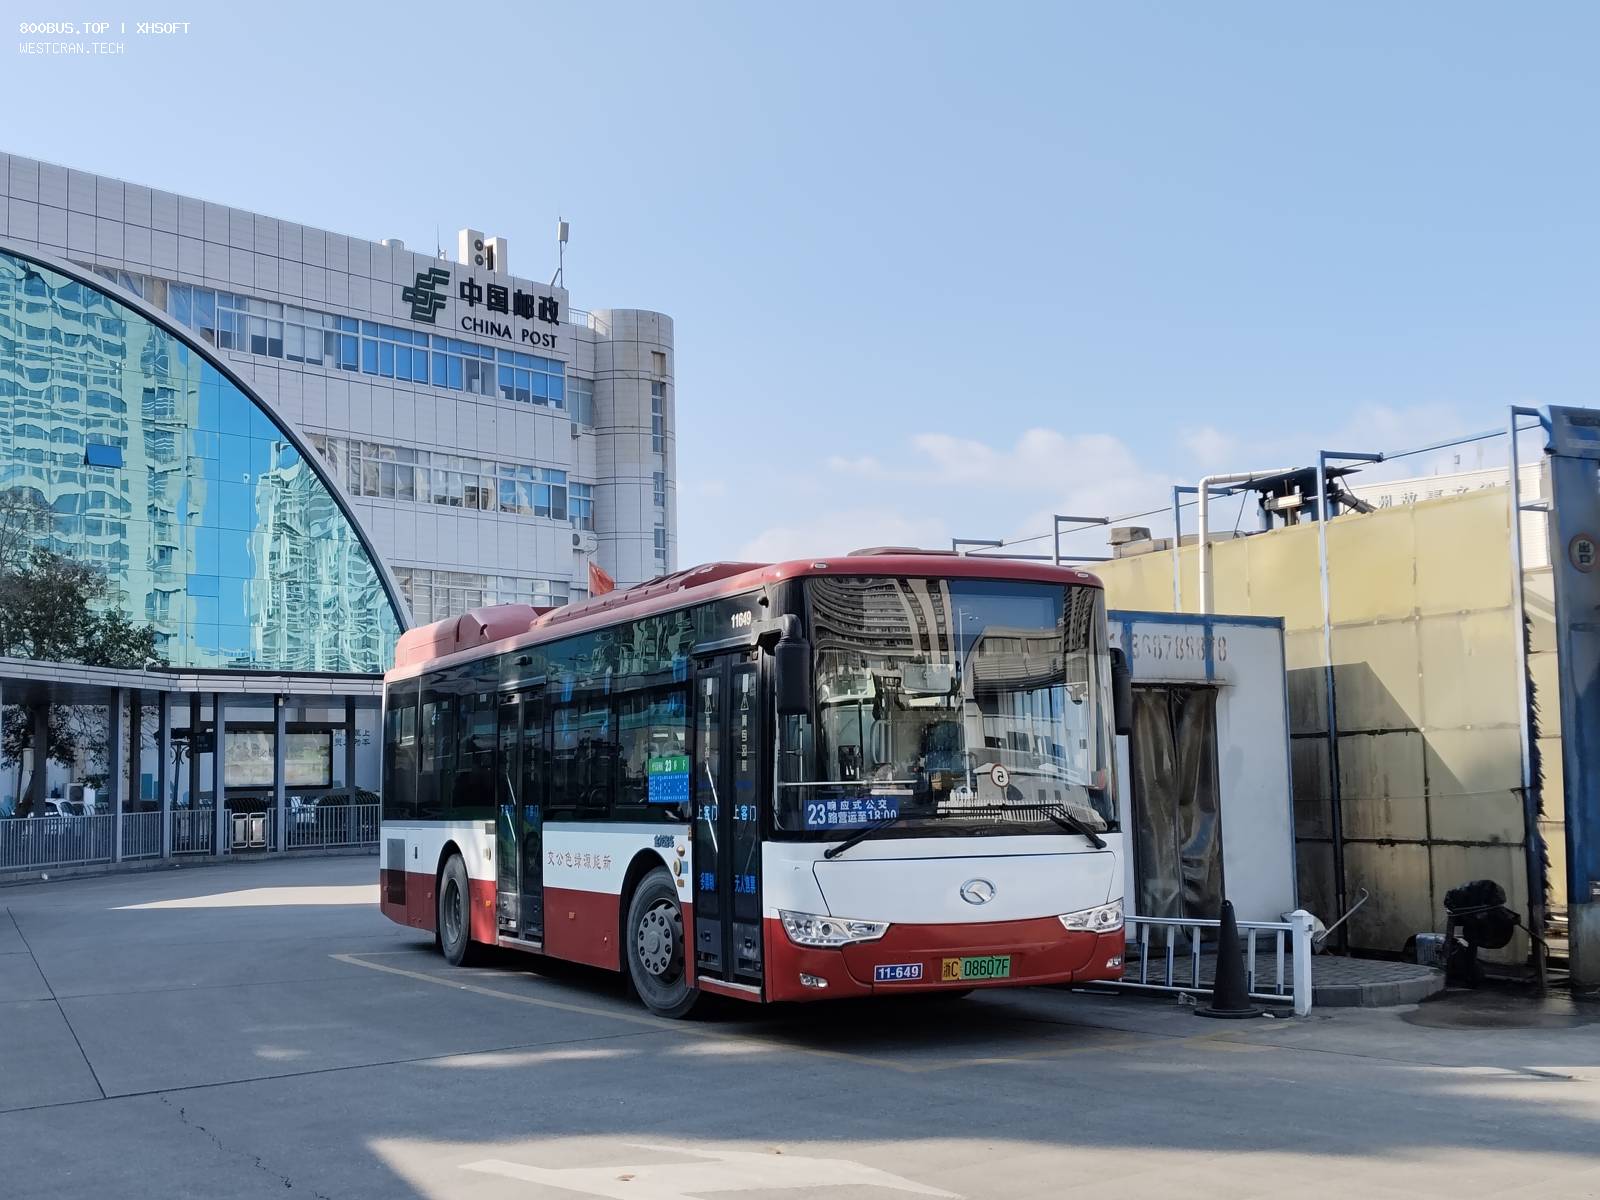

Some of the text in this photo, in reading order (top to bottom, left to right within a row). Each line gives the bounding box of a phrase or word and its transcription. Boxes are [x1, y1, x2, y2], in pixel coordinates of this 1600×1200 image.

[459, 277, 561, 326] 中国邮政
[461, 316, 558, 348] CHINA POST
[1579, 541, 1591, 563] 出口
[731, 611, 751, 629] 11649
[665, 759, 672, 772] 23
[696, 804, 718, 821] 上客门
[733, 804, 756, 821] 上客门
[808, 803, 826, 825] 23
[826, 799, 887, 811] 响应式公交
[735, 874, 756, 894] 无人售票
[878, 966, 919, 979] 11-649
[964, 958, 1009, 977] 08607F
